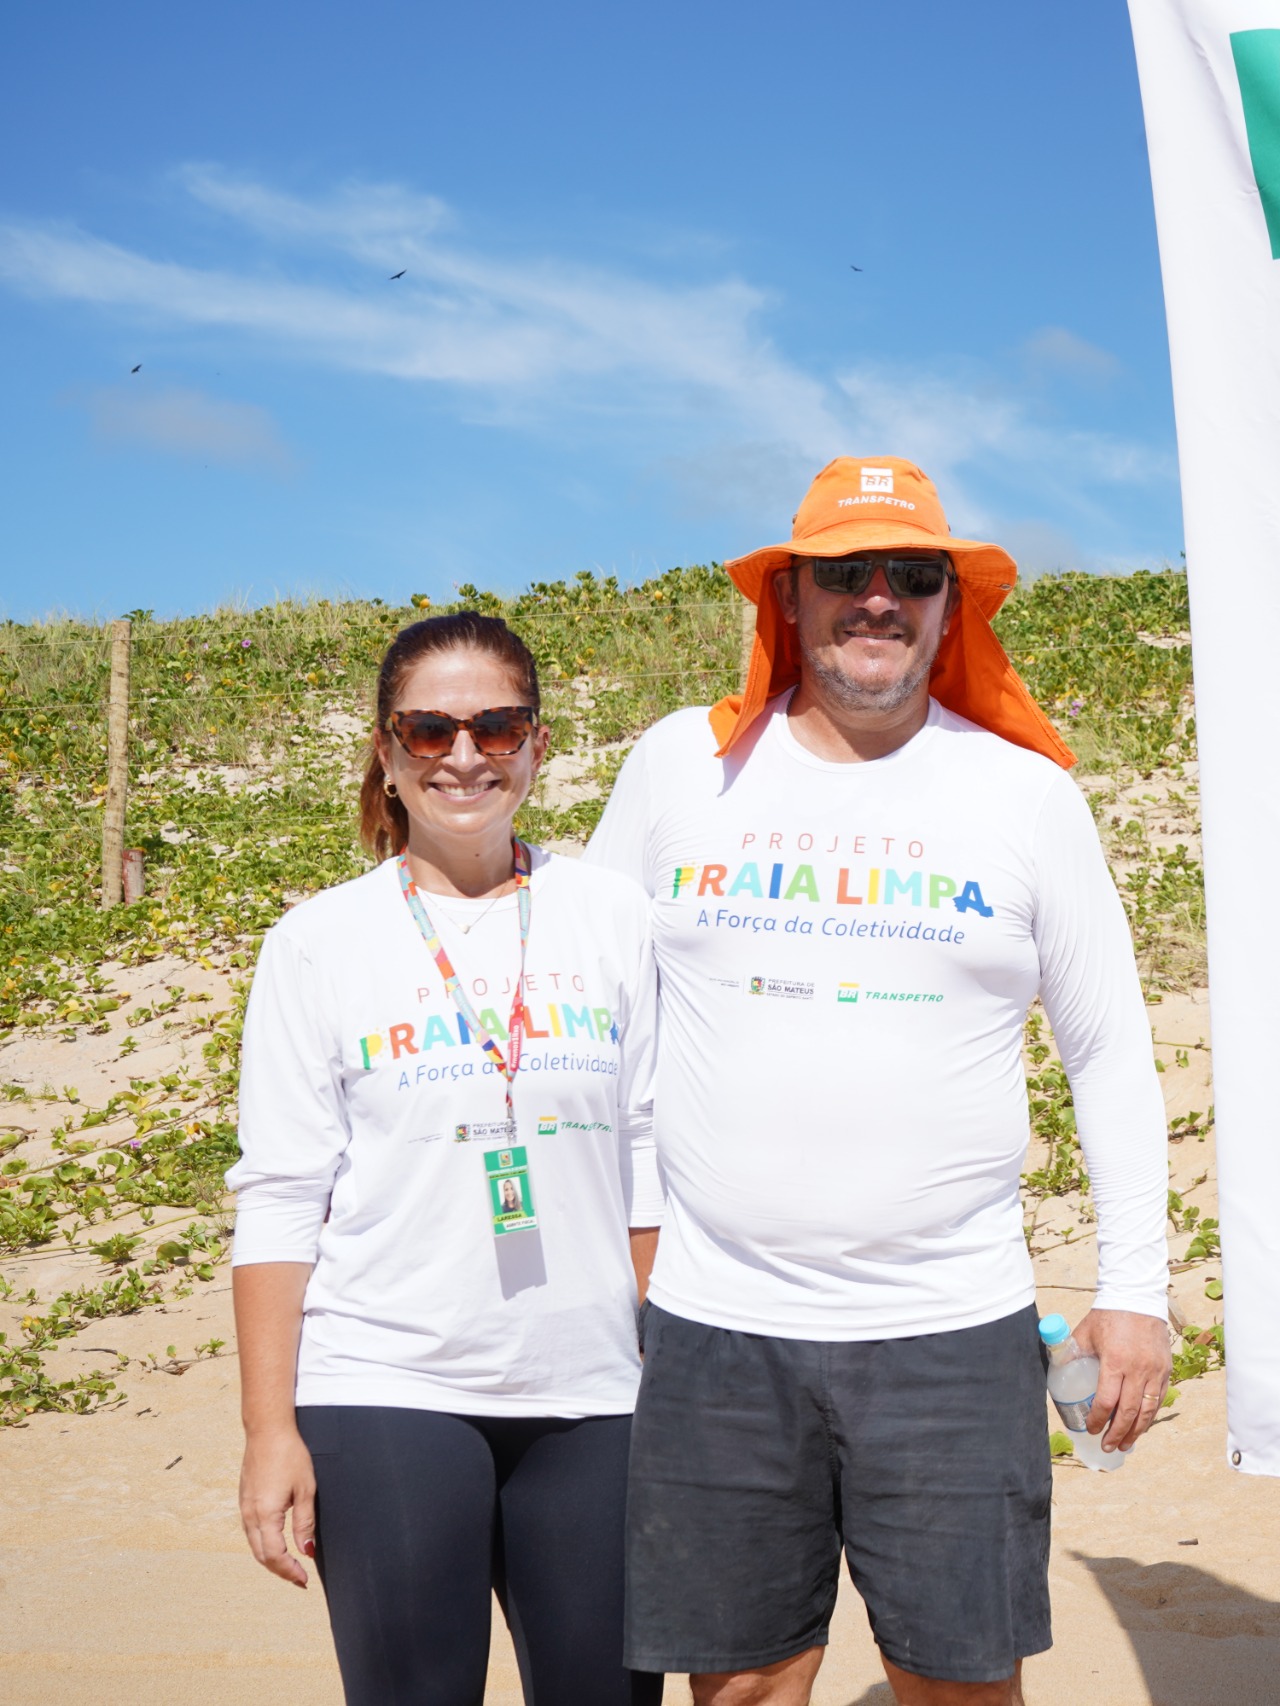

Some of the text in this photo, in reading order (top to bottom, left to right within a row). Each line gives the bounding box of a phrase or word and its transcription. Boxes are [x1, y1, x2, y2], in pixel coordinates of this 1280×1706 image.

[838, 495, 915, 510] TRANSPETRO
[742, 833, 924, 858] PROJETO
[672, 862, 994, 918] PRAIA LIMPA
[697, 910, 965, 945] A Força da Coletividade
[785, 986, 814, 994] MATEUS
[865, 991, 944, 1002] TRANSPETRO
[398, 1071, 410, 1091] A
[416, 1060, 474, 1085] Força
[518, 1053, 618, 1077] Coletividade
